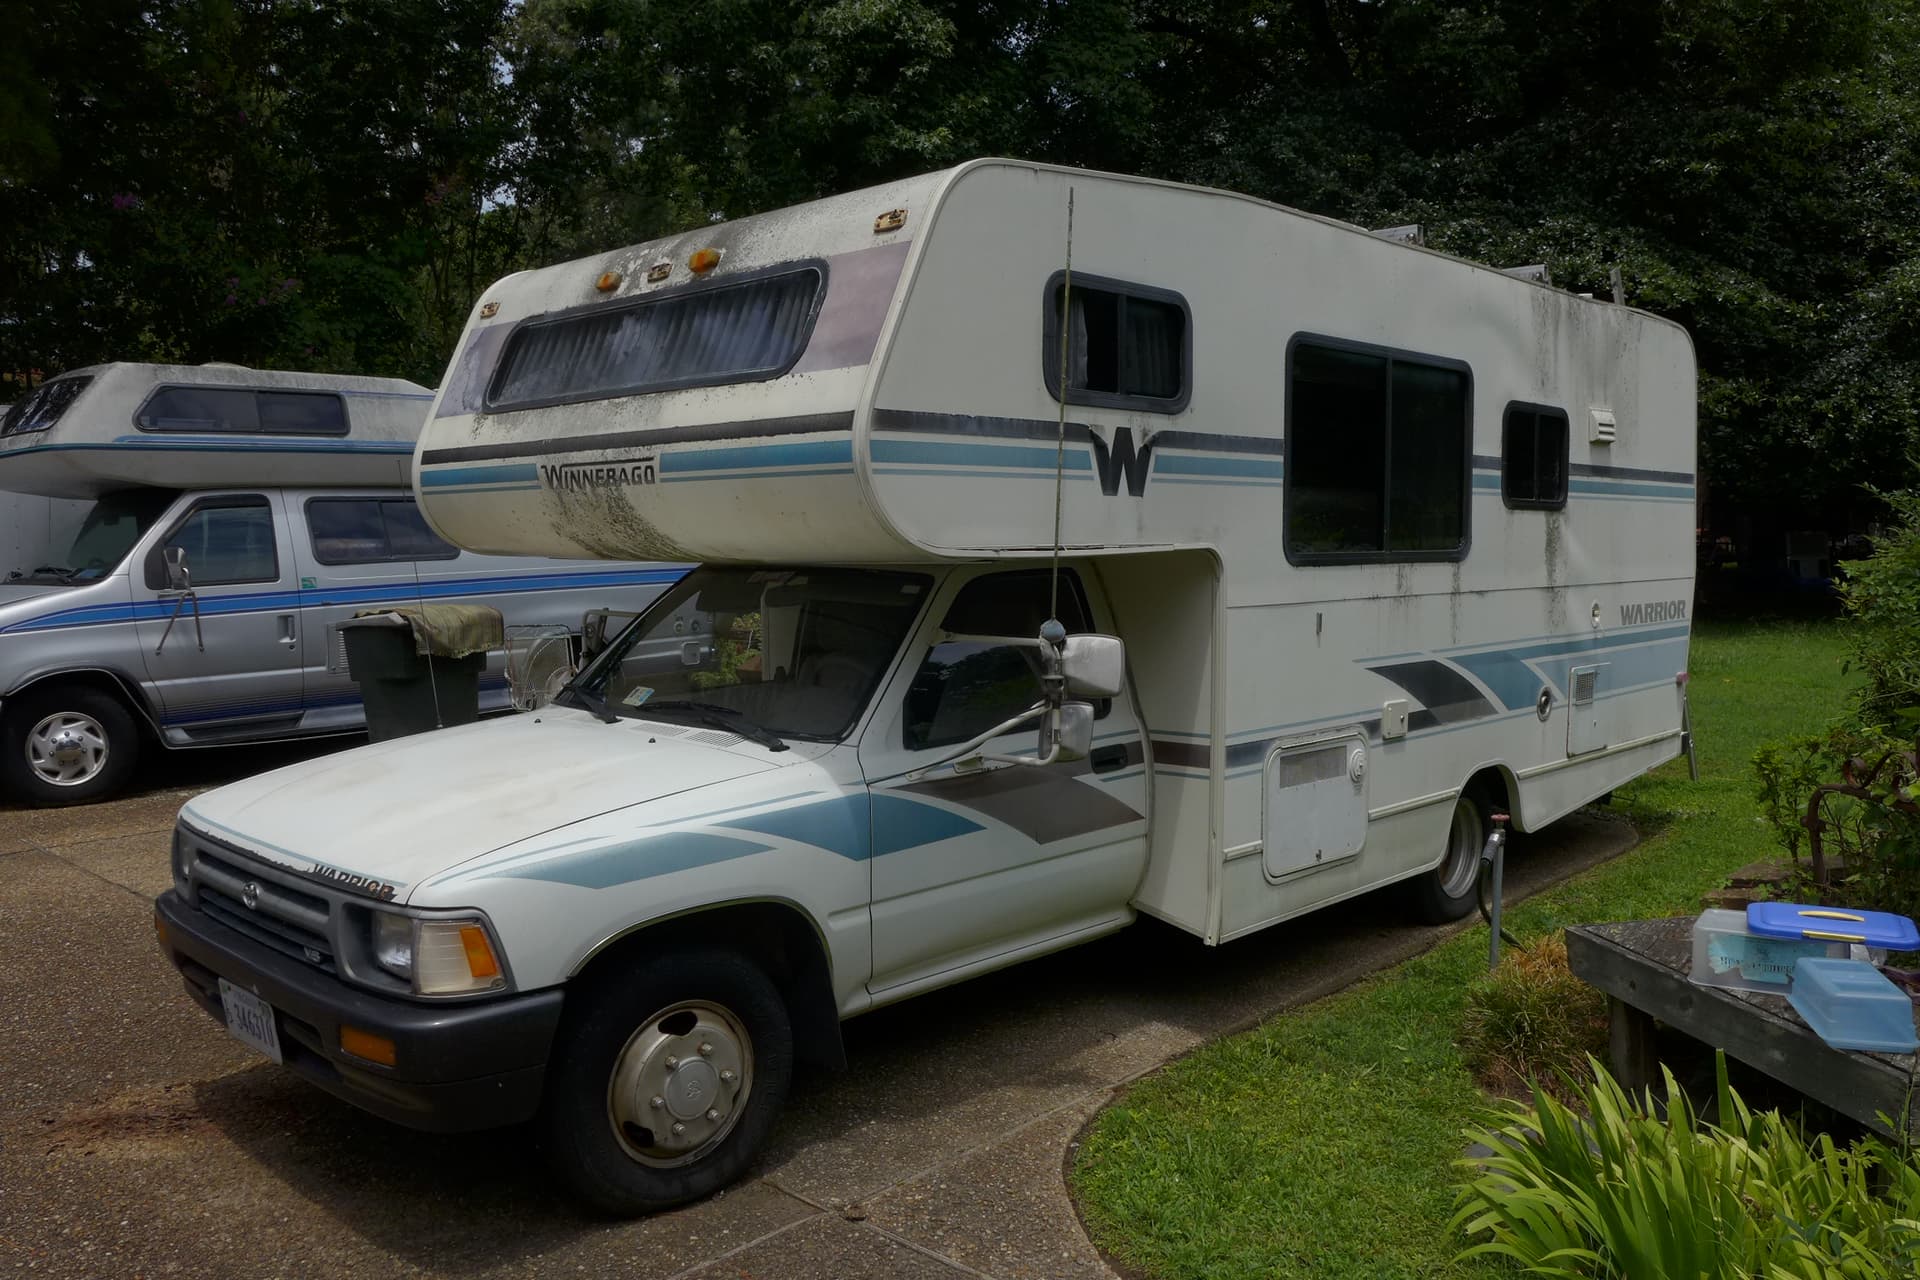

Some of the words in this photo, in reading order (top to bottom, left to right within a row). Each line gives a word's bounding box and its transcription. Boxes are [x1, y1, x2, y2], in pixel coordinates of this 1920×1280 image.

[540, 457, 656, 489] WINNEBAGO
[1089, 426, 1153, 497] W
[1620, 599, 1686, 626] WARRIOR
